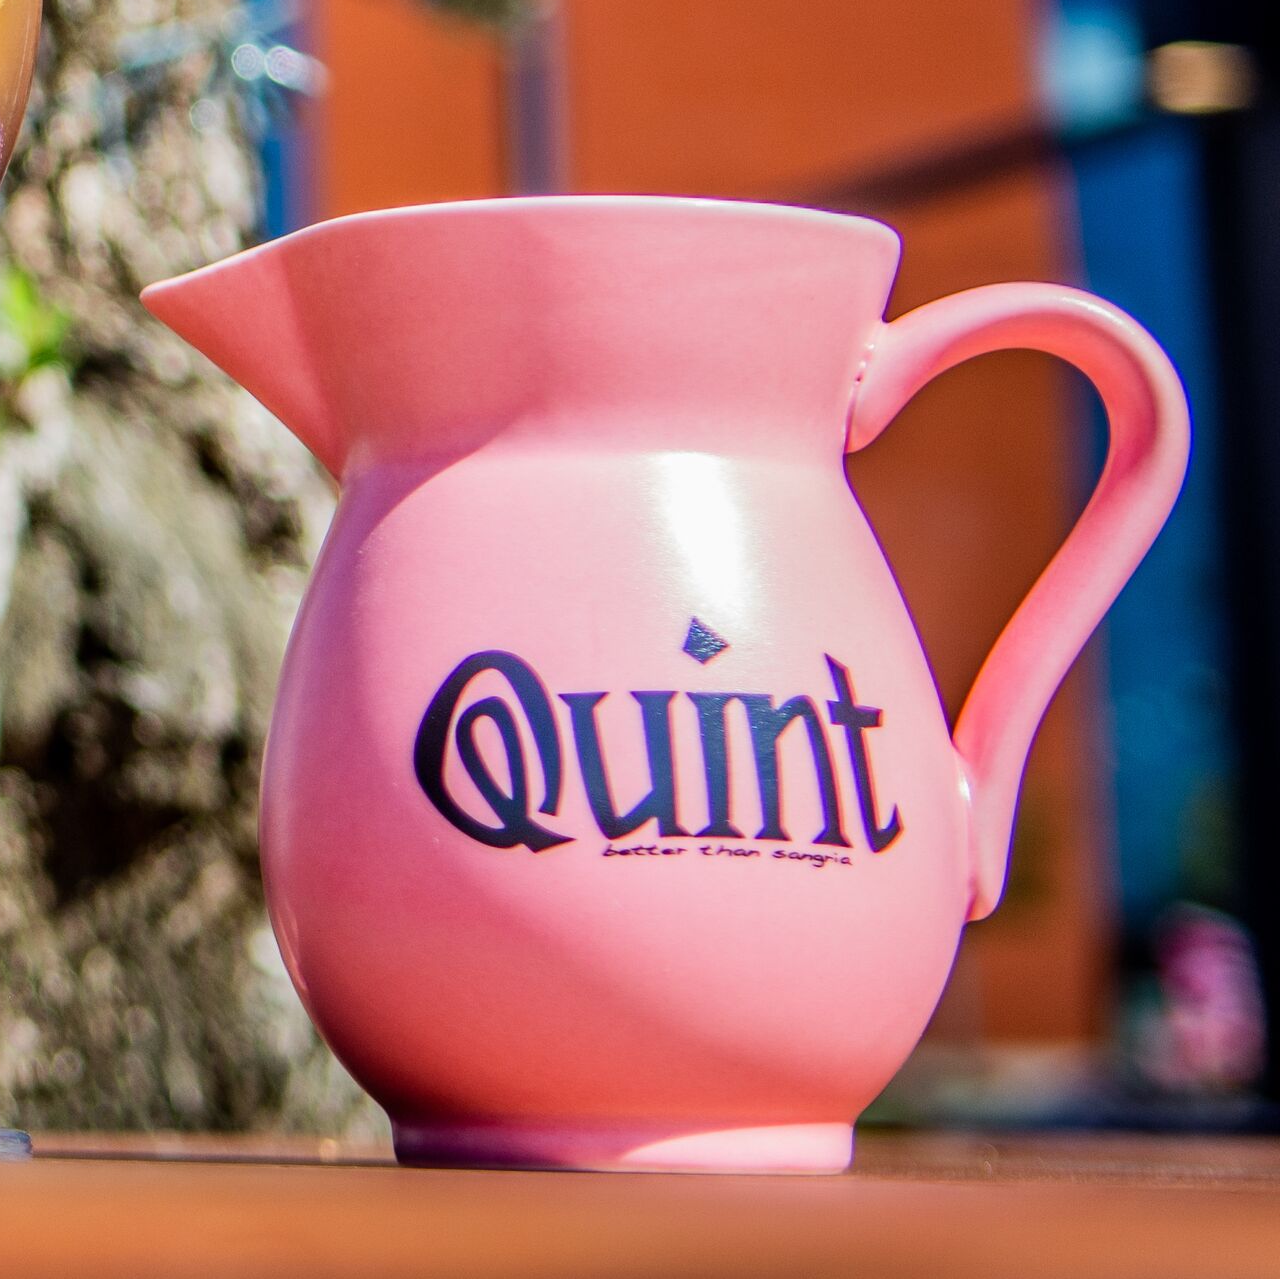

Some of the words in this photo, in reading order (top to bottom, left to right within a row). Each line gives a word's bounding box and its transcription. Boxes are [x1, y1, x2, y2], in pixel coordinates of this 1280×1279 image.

[413, 616, 905, 854] Quint
[602, 843, 688, 857] better
[699, 845, 761, 857] than
[772, 847, 853, 868] sangria
